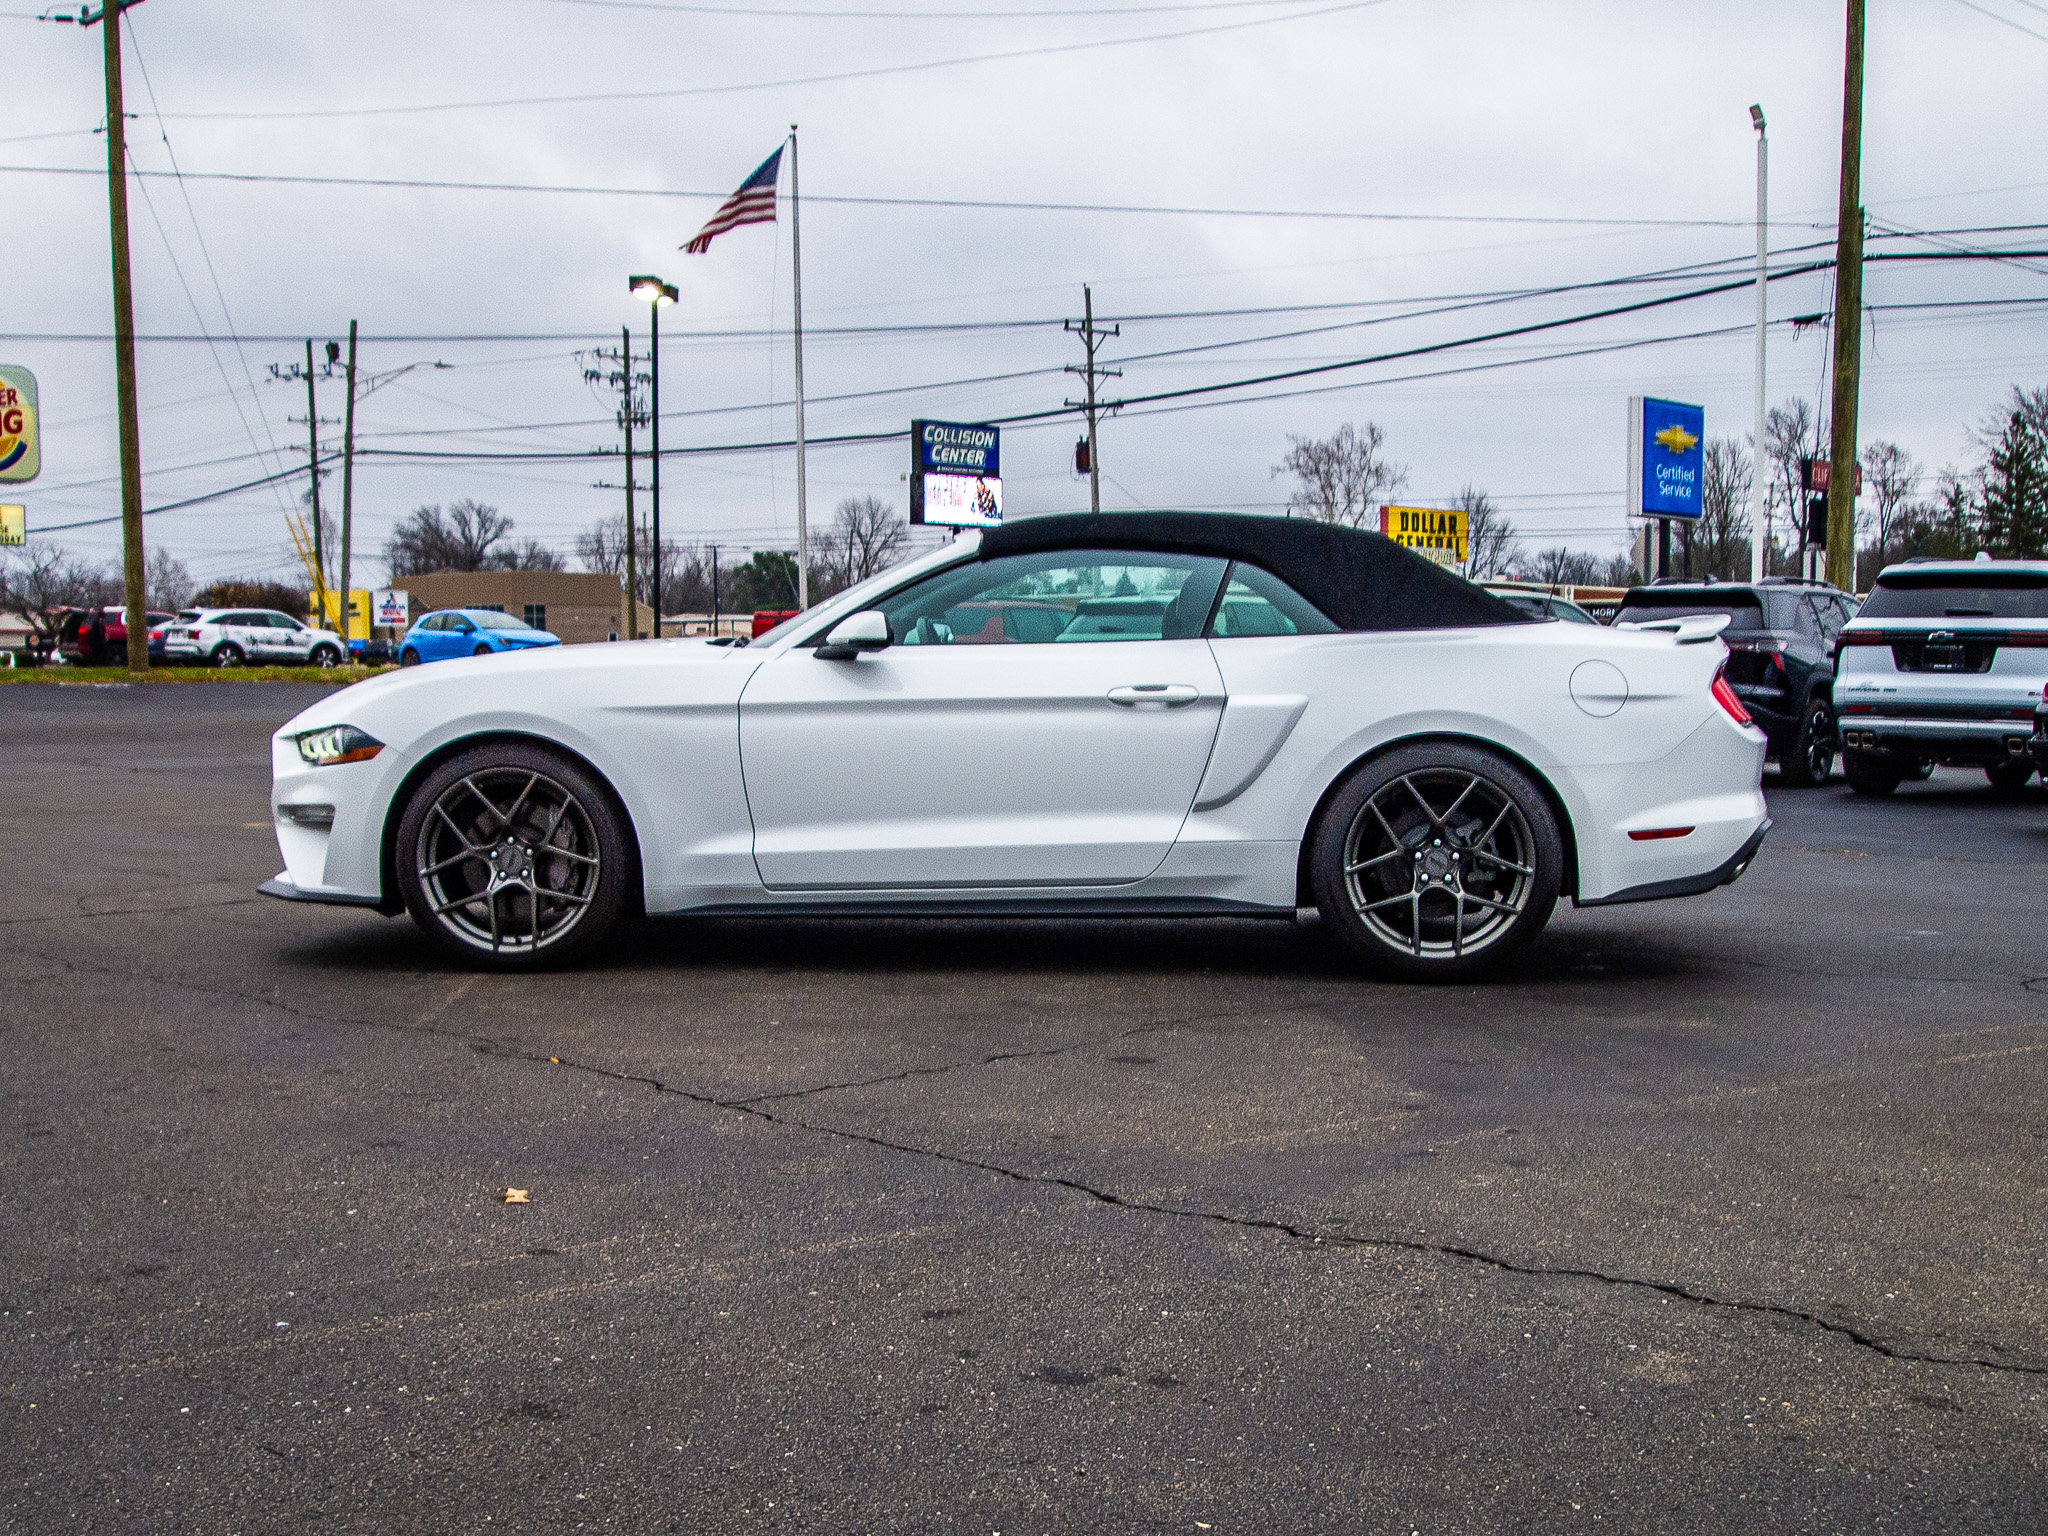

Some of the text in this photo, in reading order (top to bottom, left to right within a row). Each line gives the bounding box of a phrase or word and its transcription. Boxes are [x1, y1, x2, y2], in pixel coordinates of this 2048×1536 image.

[924, 424, 995, 449] COLLISION
[931, 444, 986, 466] CENTER
[1656, 463, 1695, 482] Certified
[1659, 480, 1692, 498] Service
[1400, 511, 1457, 536] DOLLAR
